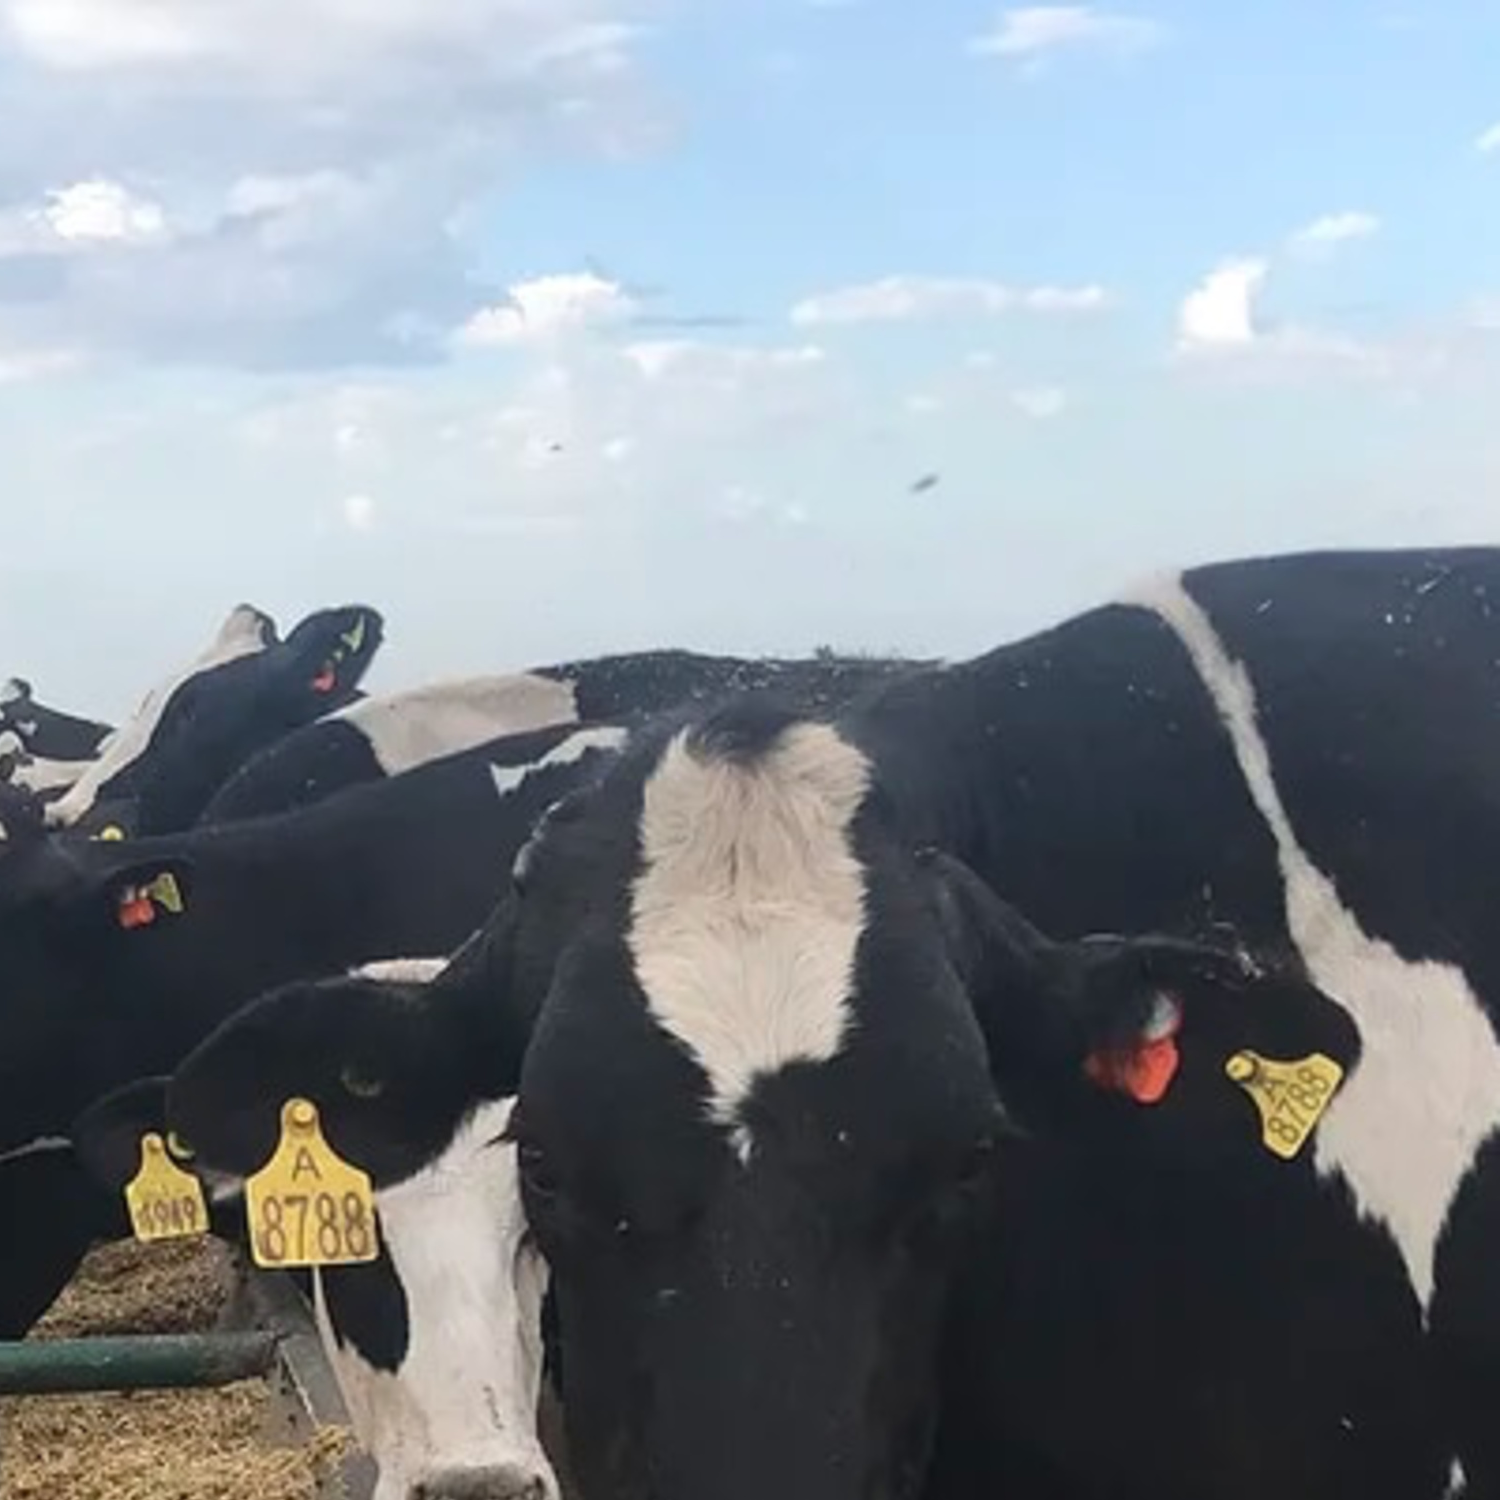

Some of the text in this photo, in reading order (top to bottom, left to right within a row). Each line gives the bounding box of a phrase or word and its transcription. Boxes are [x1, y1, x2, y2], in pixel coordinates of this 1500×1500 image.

[1266, 1069, 1331, 1144] 8788
[290, 1147, 324, 1182] A
[261, 1191, 370, 1261] 8788
